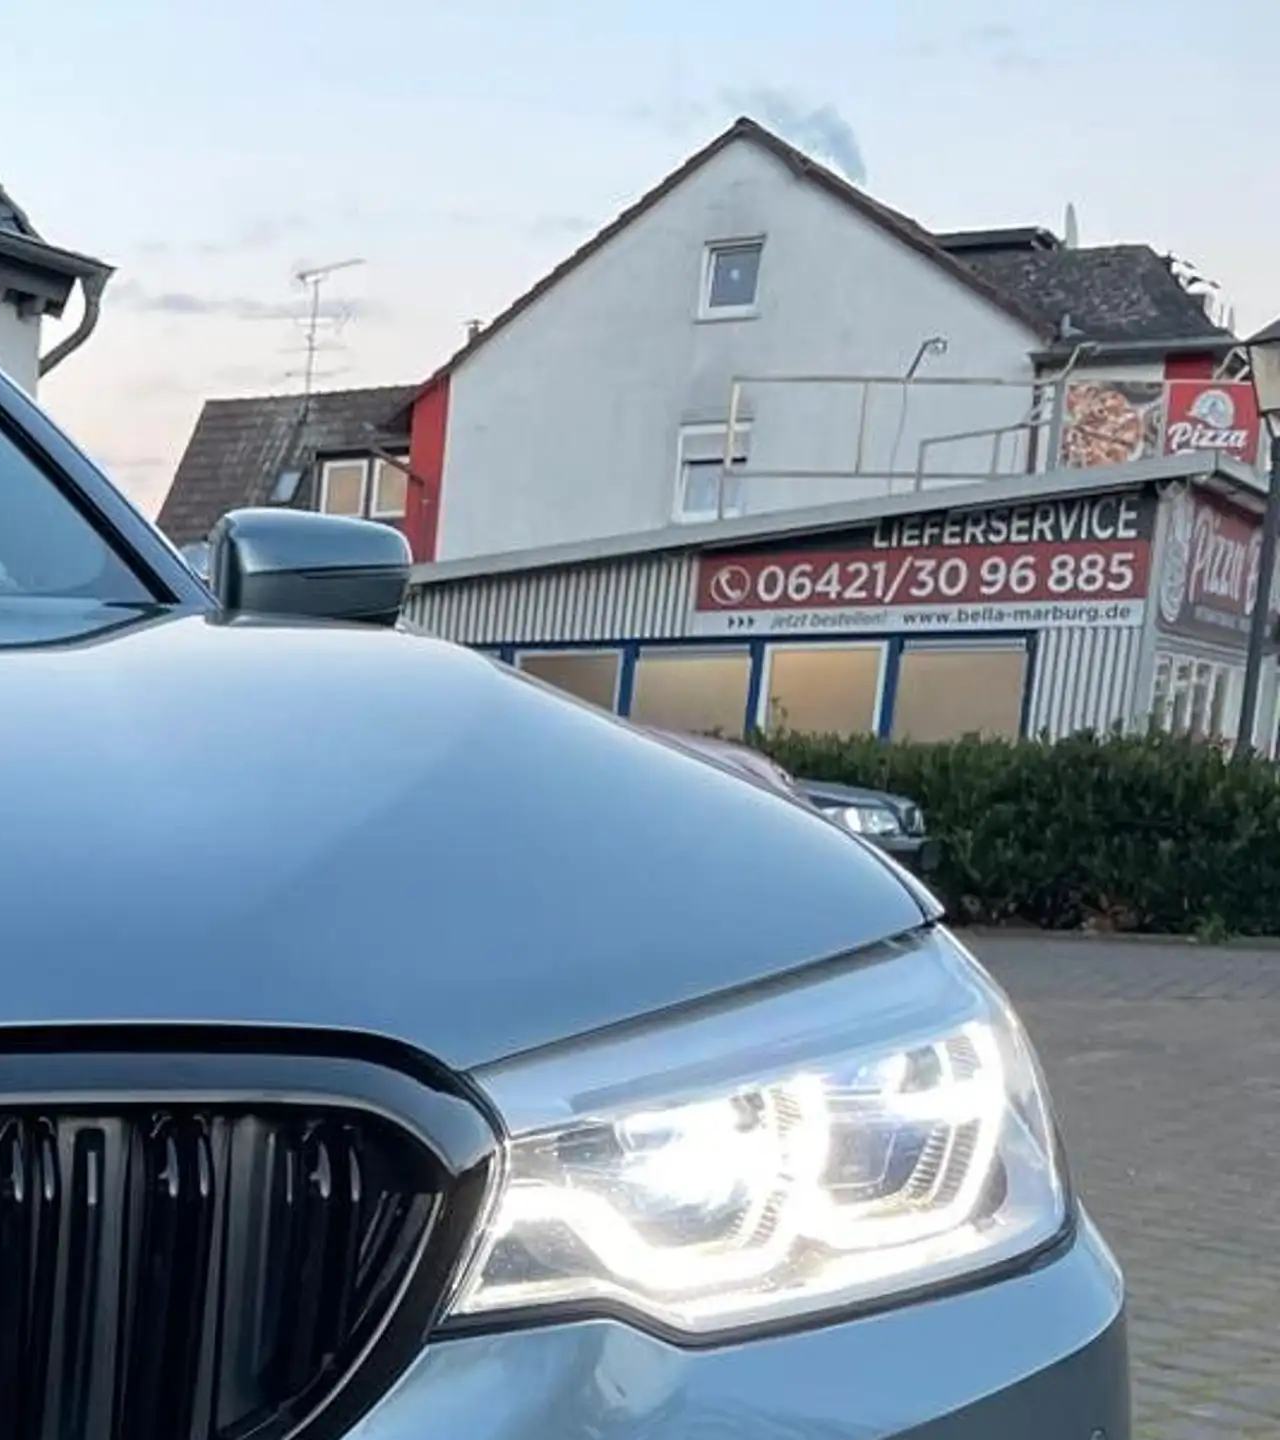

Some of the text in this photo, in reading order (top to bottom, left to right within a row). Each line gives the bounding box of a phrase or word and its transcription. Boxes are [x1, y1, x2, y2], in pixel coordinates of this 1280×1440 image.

[1168, 421, 1248, 450] Pizza
[874, 498, 1139, 548] LIEFERSERVICE
[757, 551, 1135, 604] 06421/30 96 885
[902, 603, 1131, 627] www.bella-marburg.de
